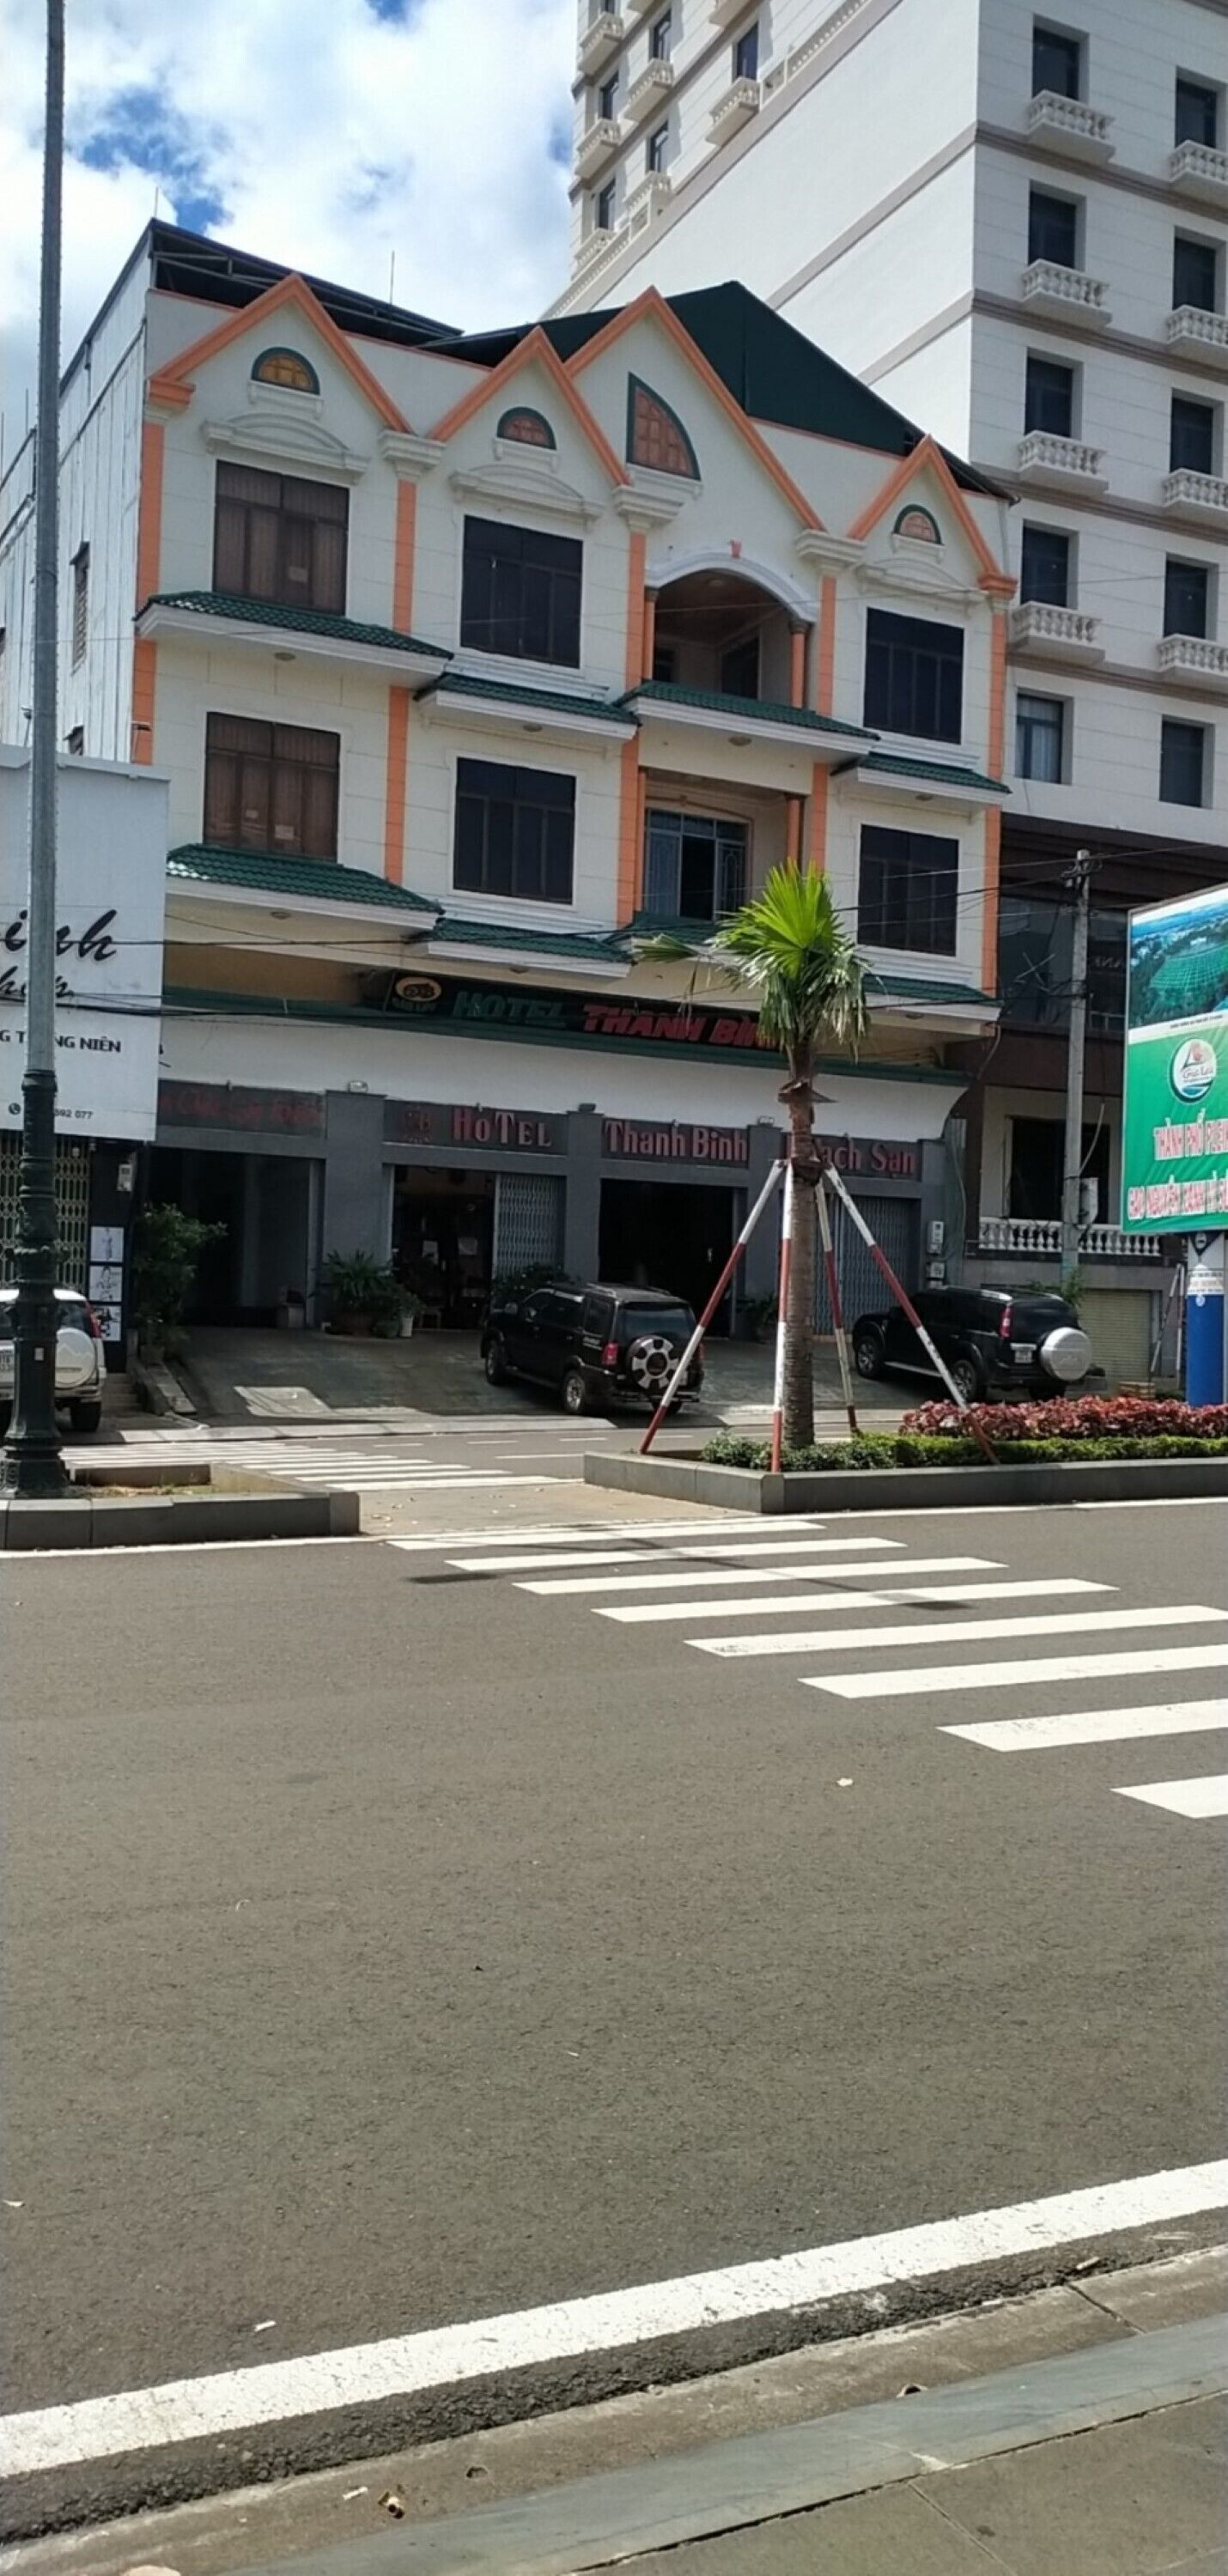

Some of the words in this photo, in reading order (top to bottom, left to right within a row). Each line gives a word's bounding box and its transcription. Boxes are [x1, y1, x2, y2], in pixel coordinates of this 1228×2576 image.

[453, 990, 567, 1028] HOTEL
[585, 1003, 706, 1042] THANH
[80, 1036, 121, 1053] NIÊN
[605, 1121, 687, 1157] Thanh
[1154, 1117, 1184, 1160] THÀNH
[1185, 1108, 1205, 1157] PHỐ
